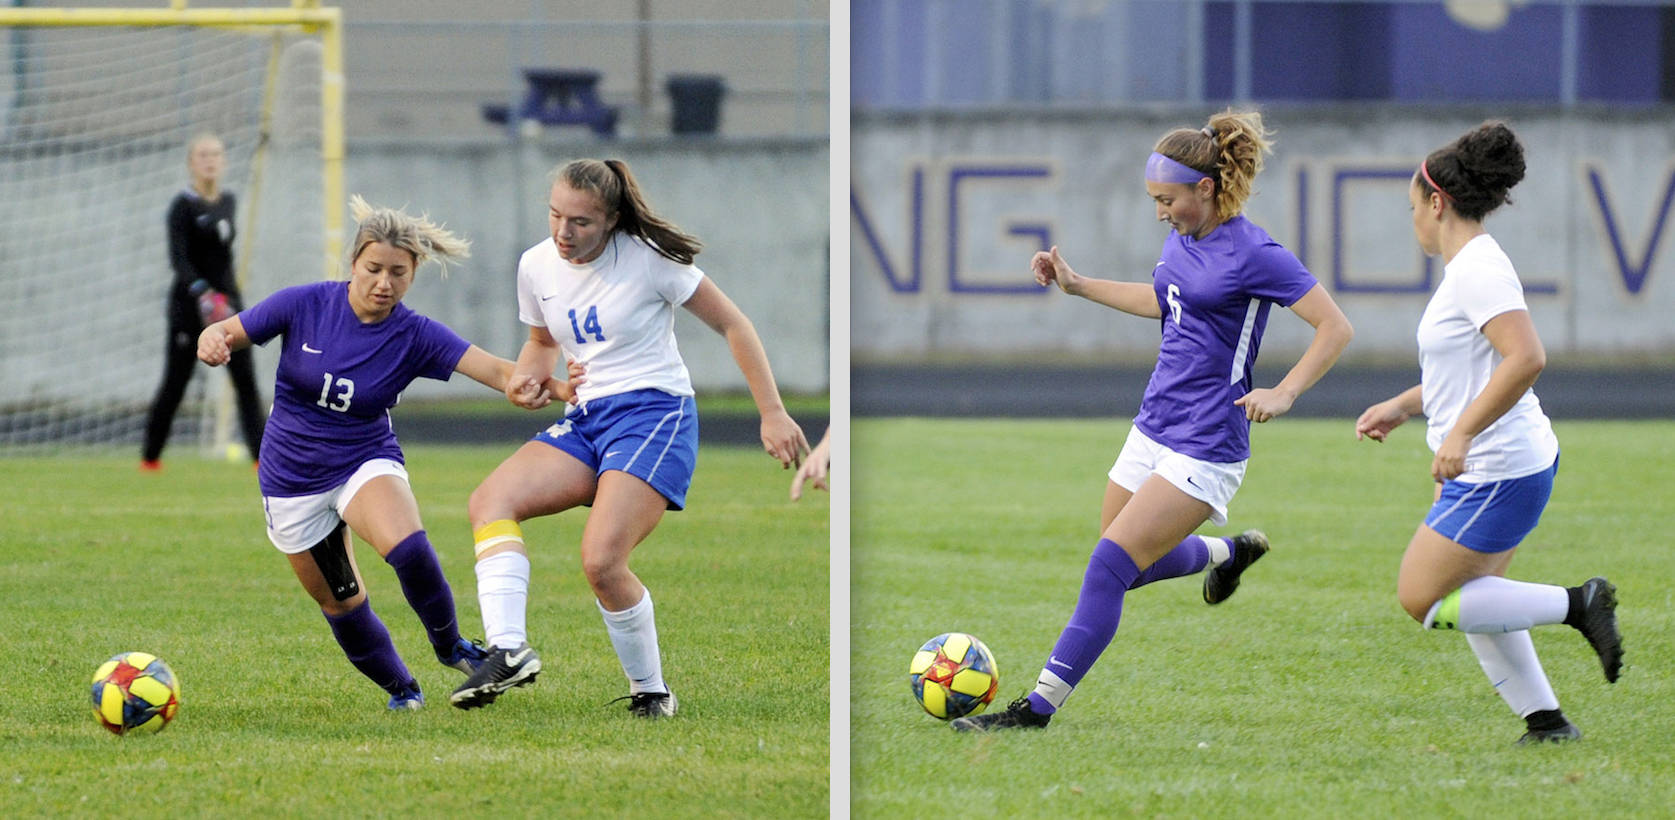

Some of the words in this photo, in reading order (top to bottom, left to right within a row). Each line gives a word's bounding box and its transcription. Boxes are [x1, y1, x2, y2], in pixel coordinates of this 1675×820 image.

[567, 305, 607, 344] 14
[1166, 283, 1183, 326] 6
[316, 372, 355, 413] 13
